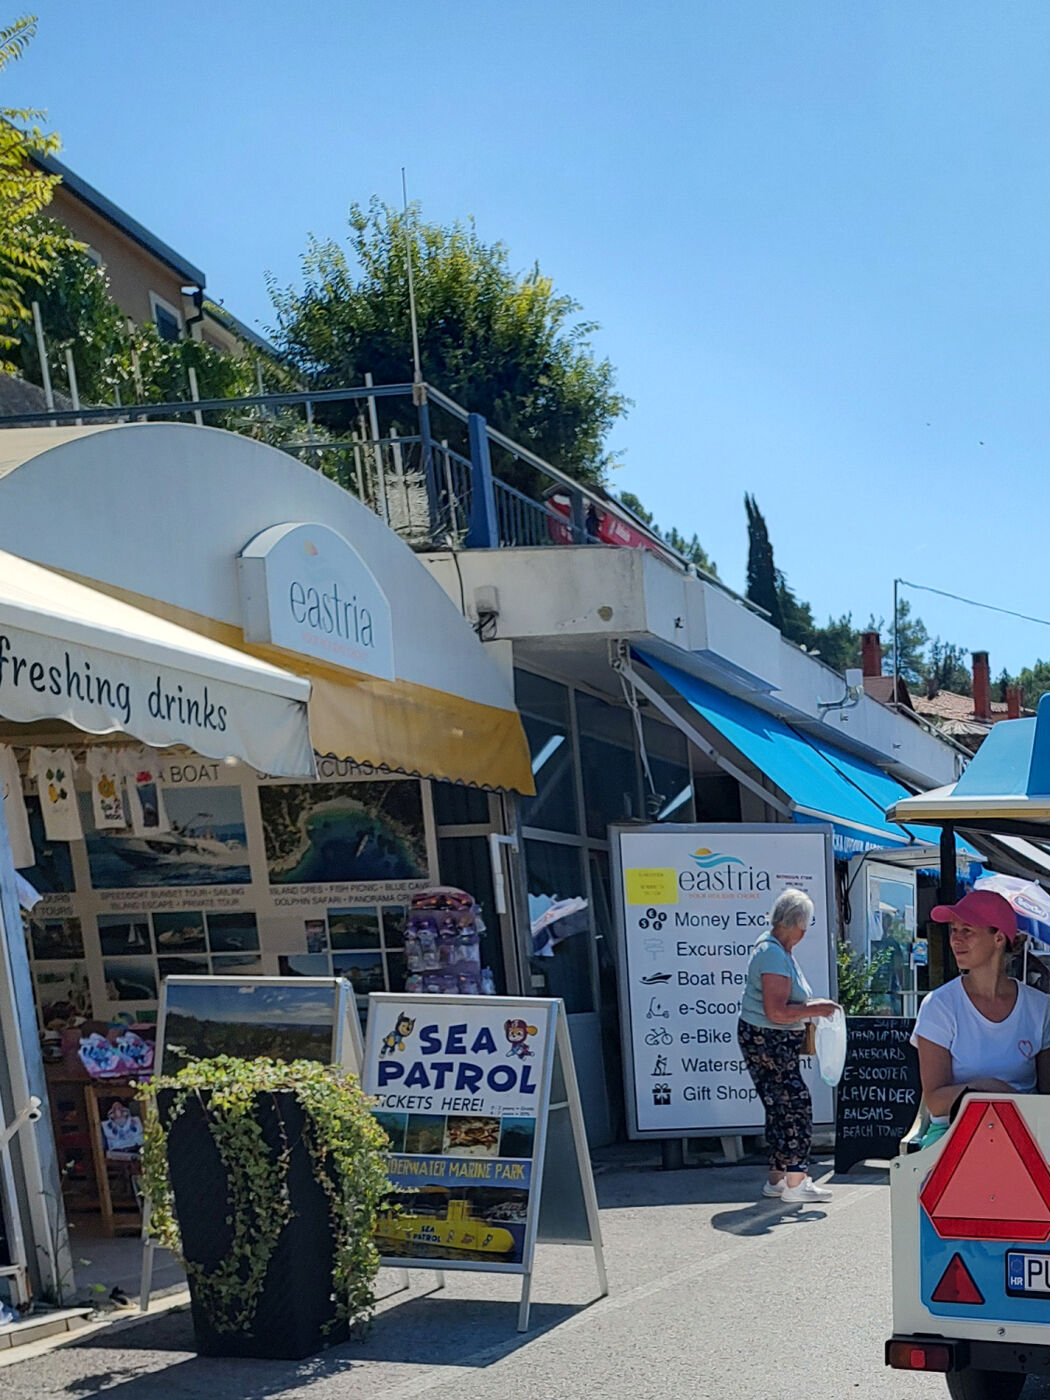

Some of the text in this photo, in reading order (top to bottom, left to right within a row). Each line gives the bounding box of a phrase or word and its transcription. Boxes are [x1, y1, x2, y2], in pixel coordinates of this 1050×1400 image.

[290, 581, 375, 649] eastria
[147, 675, 228, 732] drinks
[170, 763, 221, 784] BOAT
[679, 864, 772, 891] eastria
[674, 912, 730, 930] Money
[678, 970, 715, 986] Boat
[679, 1000, 742, 1015] e-Scoot
[419, 1023, 498, 1056] SEA
[680, 1029, 732, 1044] e-Bike
[848, 1047, 906, 1061] AKEBOARD
[377, 1060, 537, 1095] PATROL
[843, 1066, 909, 1081] E-SCOOTER
[683, 1086, 758, 1104] Gift Shop
[841, 1085, 916, 1105] LAVENDER
[441, 1096, 485, 1112] HERE!
[843, 1106, 894, 1120] BALSAMS
[842, 1124, 907, 1138] BEACH TOWE
[388, 1158, 526, 1180] DERWATER MARINE PARK
[421, 1225, 435, 1233] SEA
[413, 1233, 441, 1243] PATROL
[1010, 1276, 1023, 1286] HR
